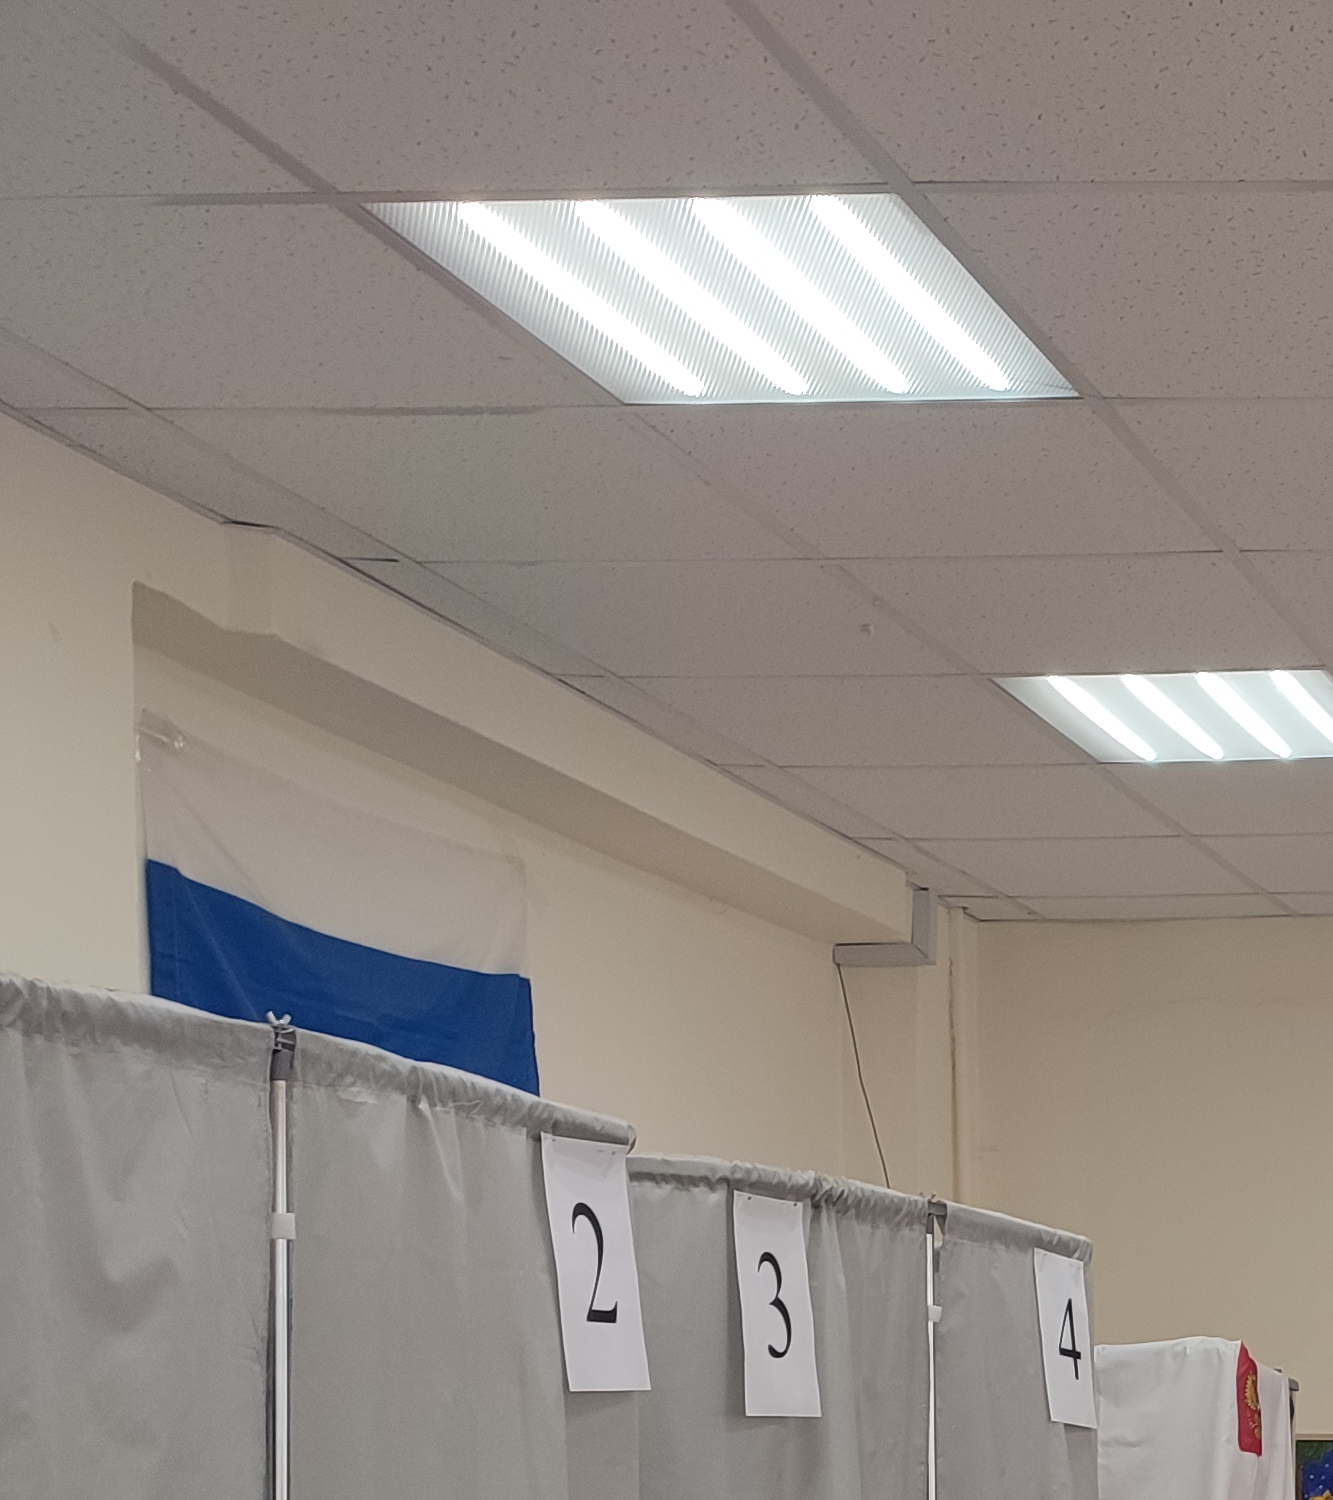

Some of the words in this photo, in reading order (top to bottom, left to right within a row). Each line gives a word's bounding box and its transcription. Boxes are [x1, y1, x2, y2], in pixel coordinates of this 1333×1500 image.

[571, 1202, 618, 1324] 2
[757, 1251, 793, 1359] 3
[1058, 1298, 1082, 1380] 4
